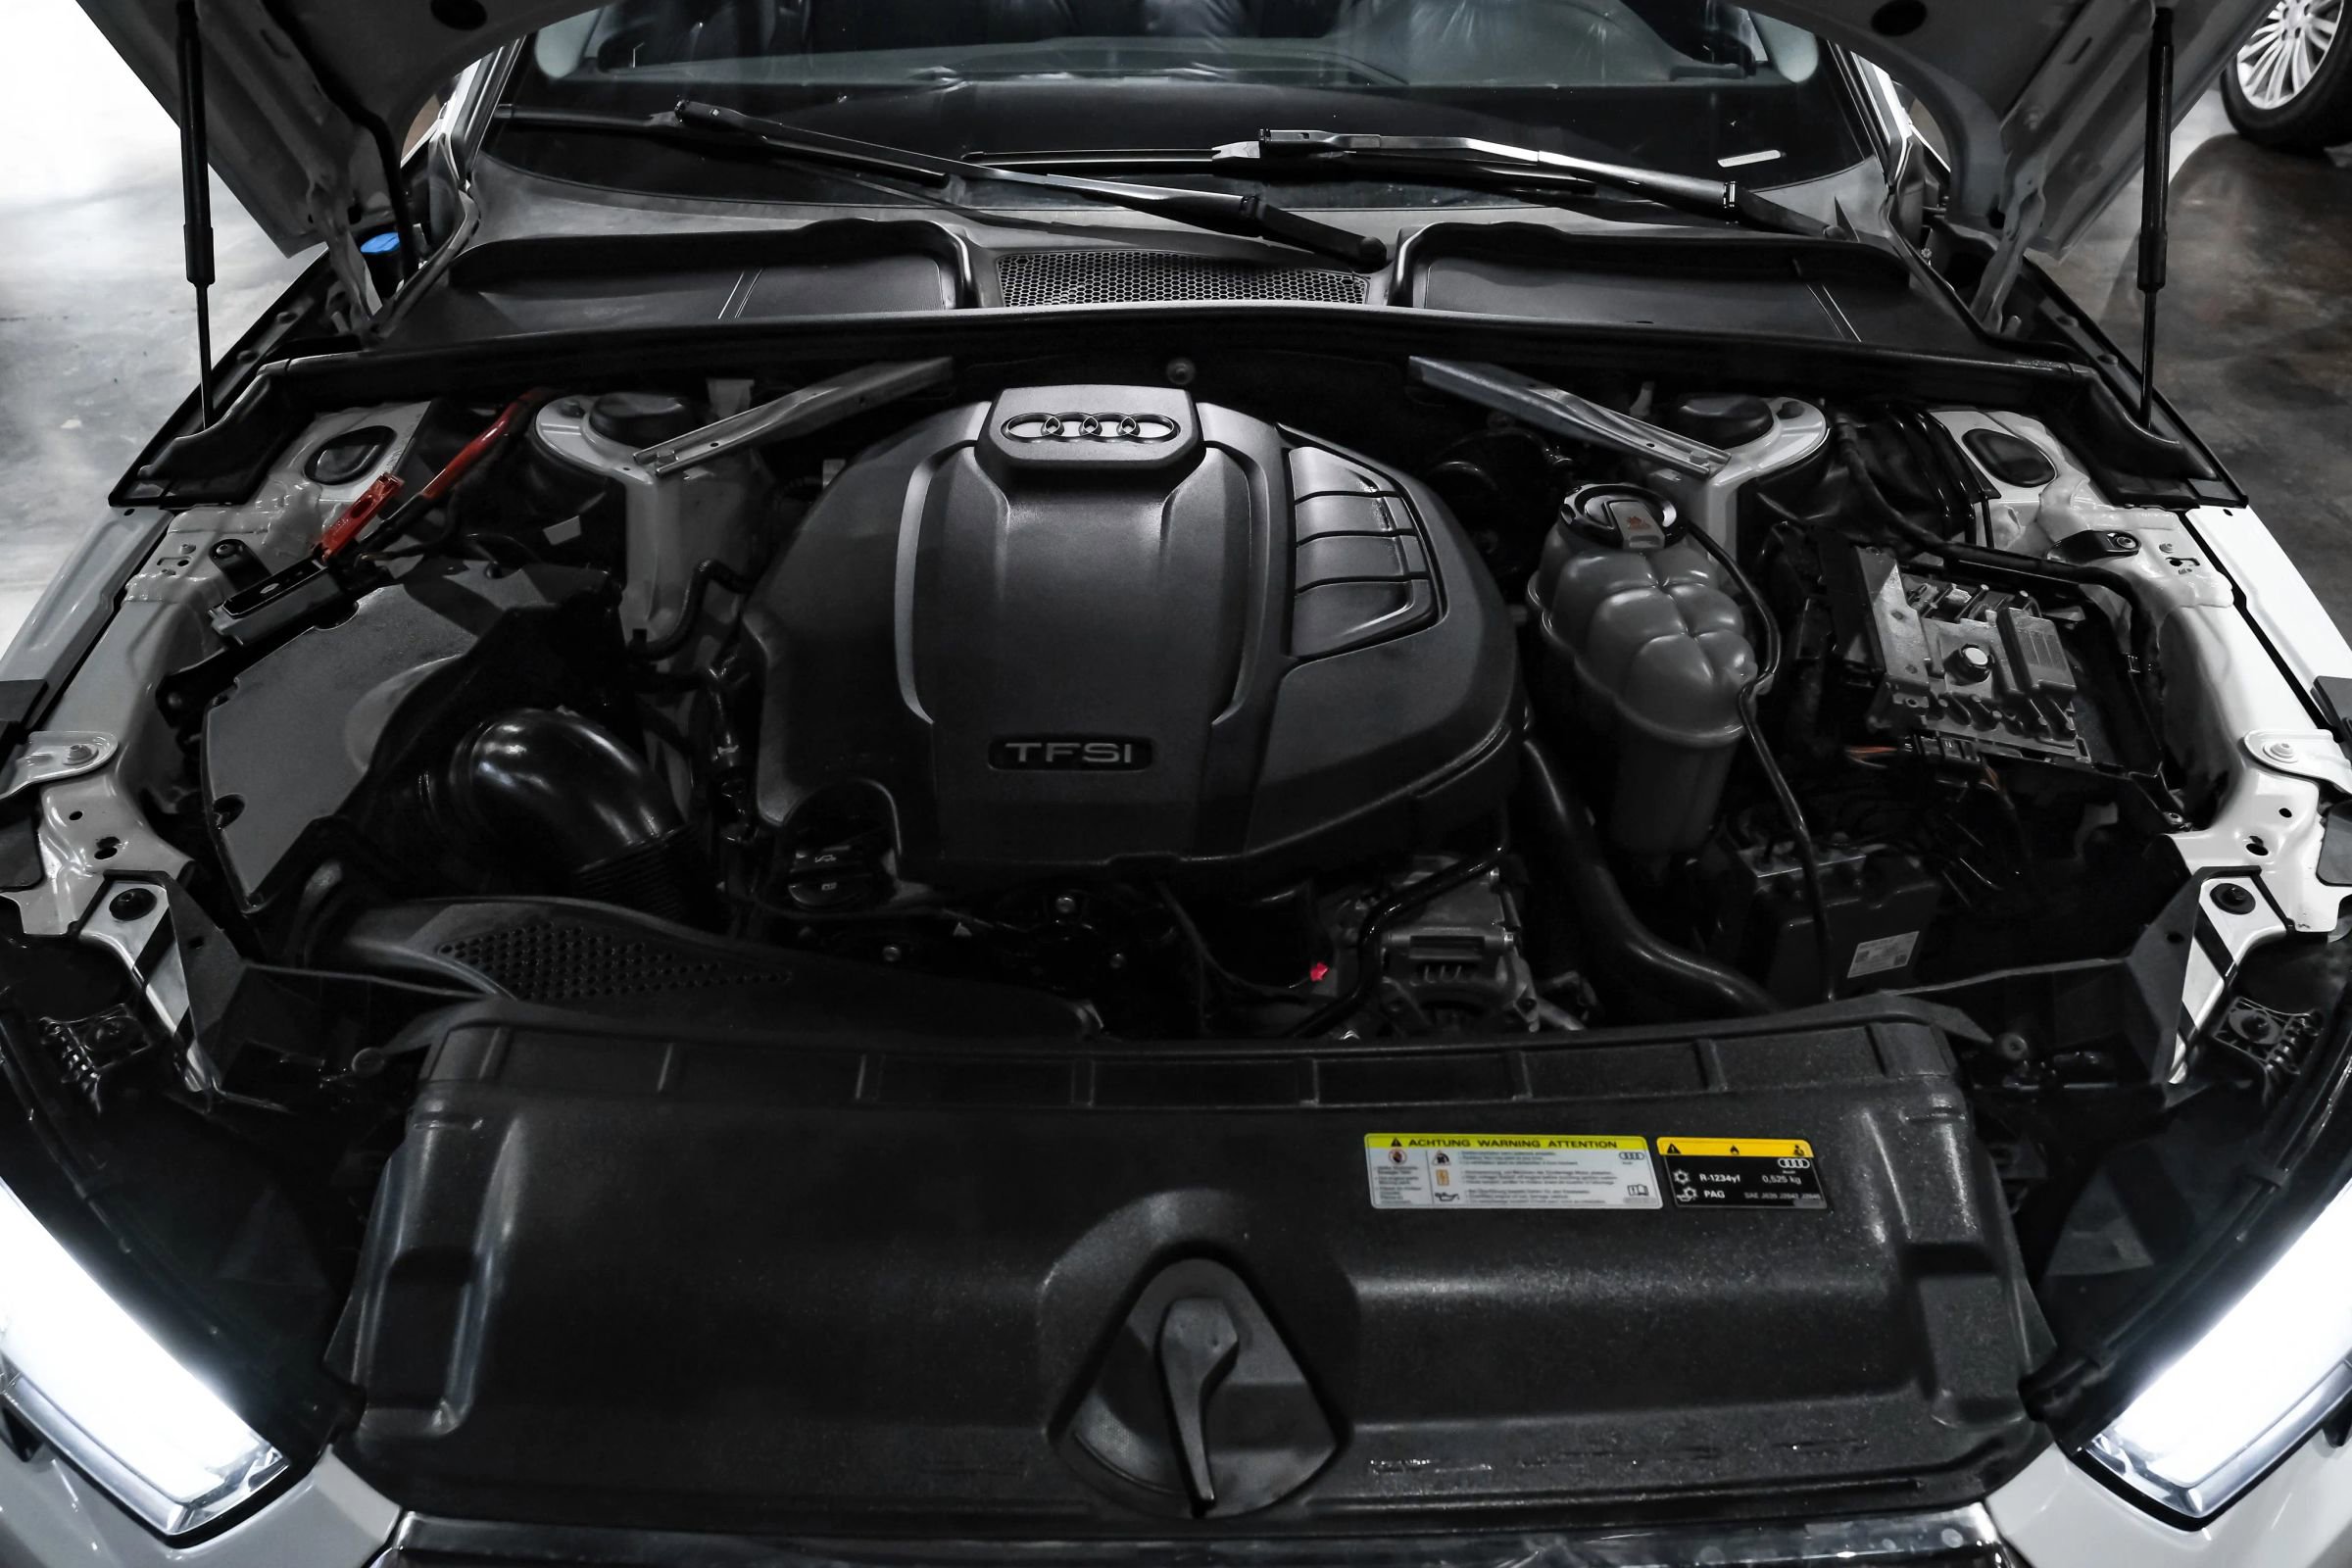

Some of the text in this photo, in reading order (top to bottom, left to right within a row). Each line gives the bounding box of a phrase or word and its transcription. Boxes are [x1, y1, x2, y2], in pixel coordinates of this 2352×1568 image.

[1004, 742, 1132, 763] TFSI
[1408, 1138, 1618, 1150] ACHTUNG WARNING ATTENTION
[1789, 1175, 1802, 1186] kg
[1703, 1189, 1726, 1199] PAG
